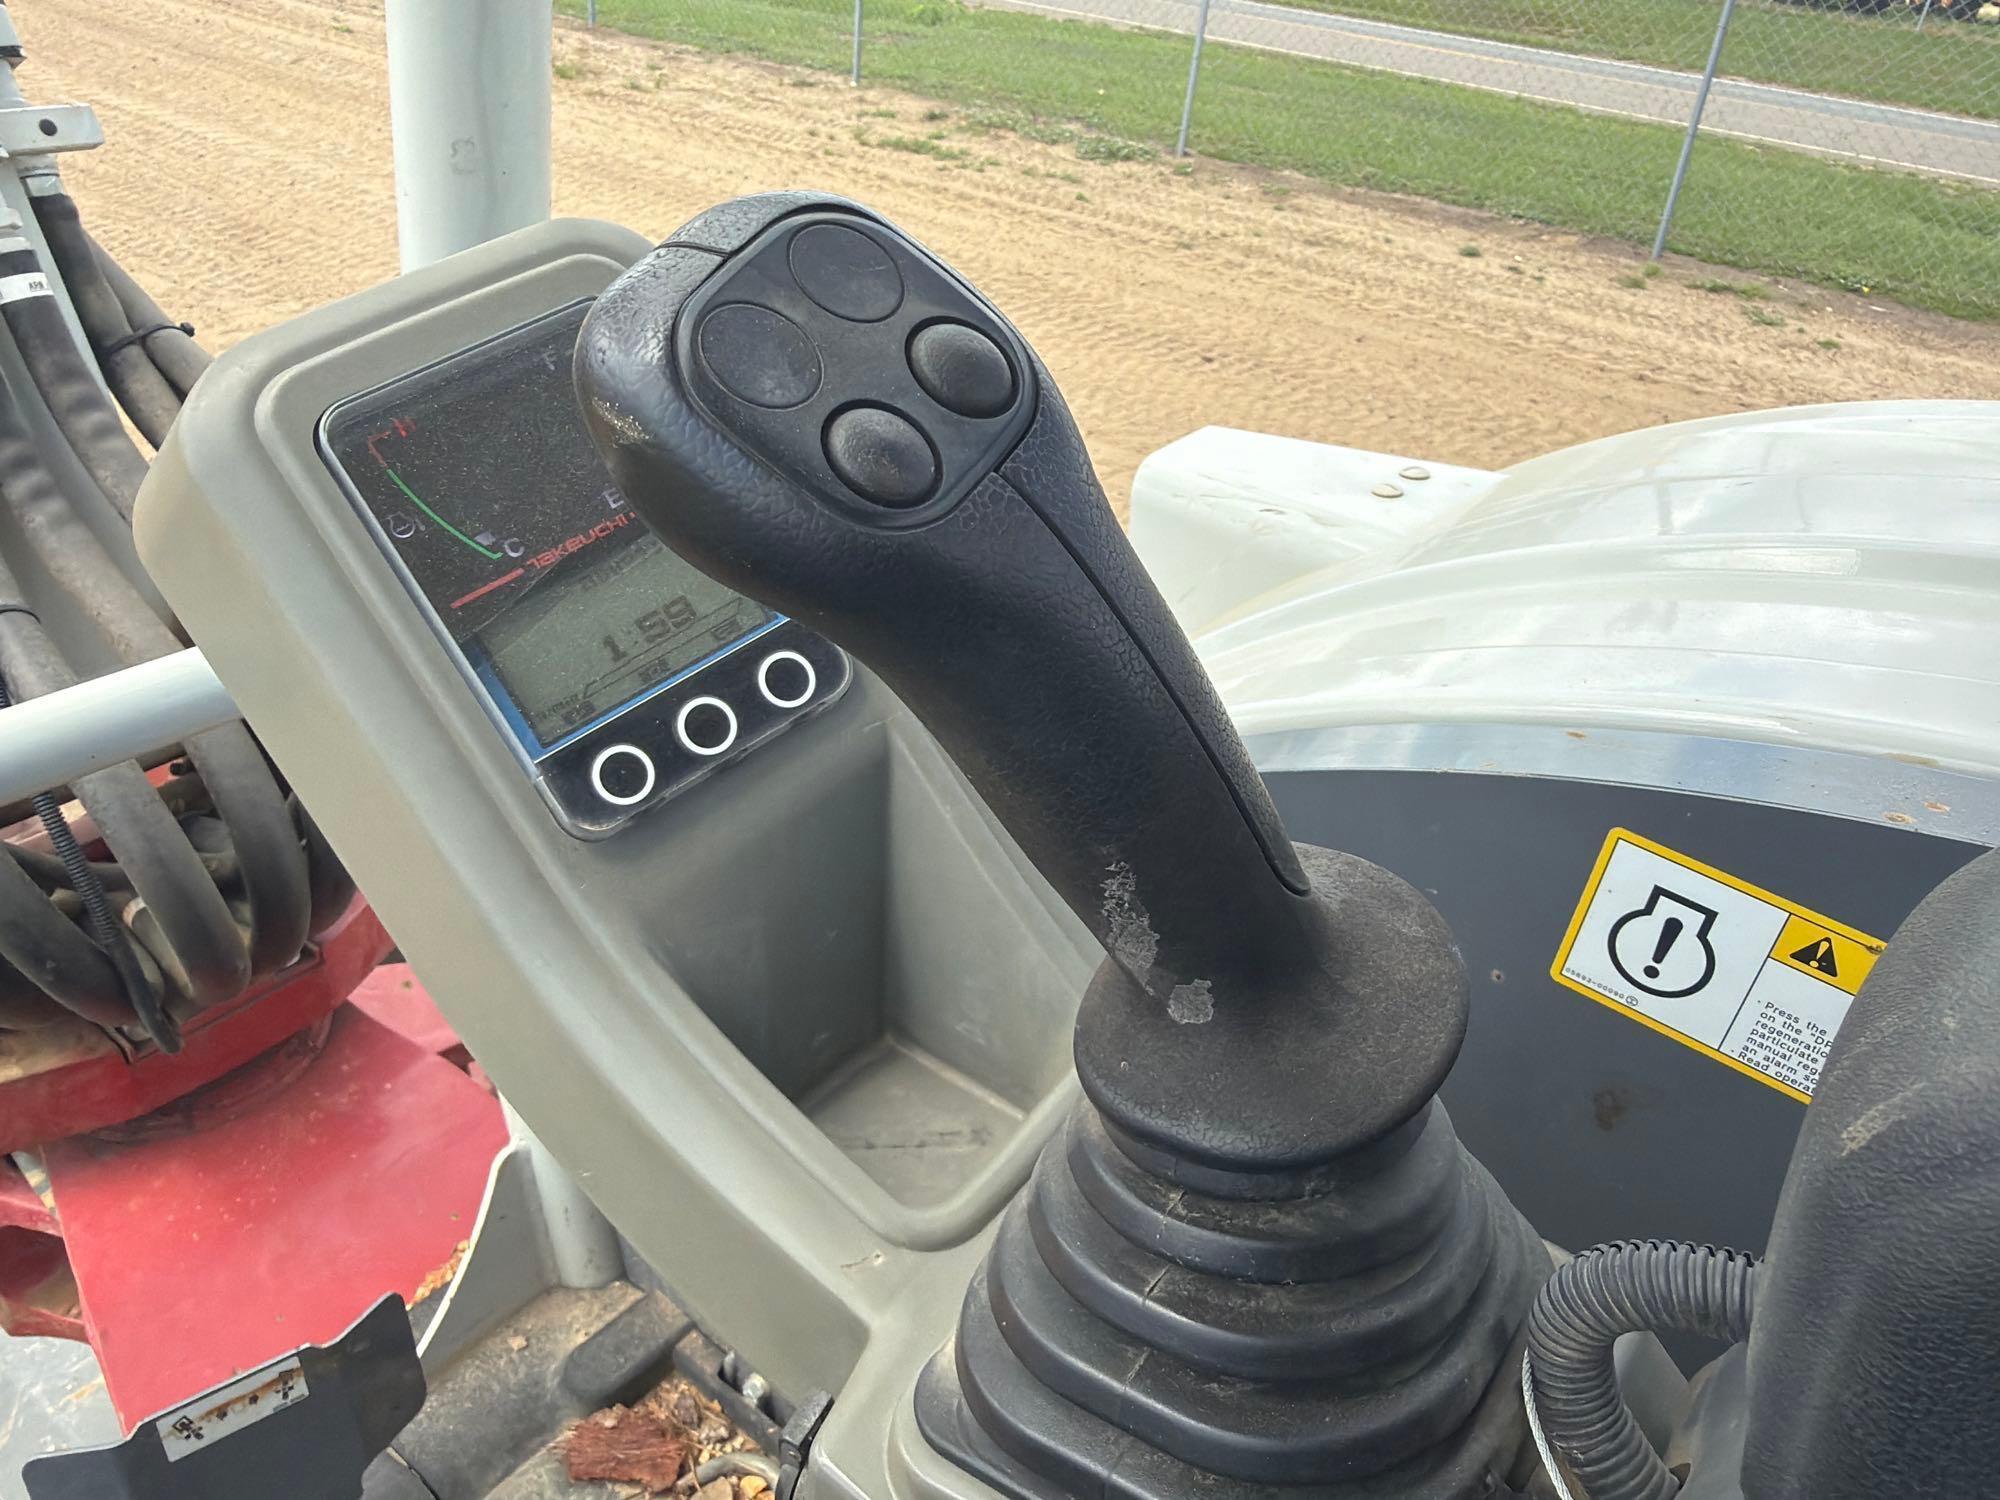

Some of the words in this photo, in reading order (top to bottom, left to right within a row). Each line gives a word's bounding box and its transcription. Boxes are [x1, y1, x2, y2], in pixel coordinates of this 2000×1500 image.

[601, 487, 625, 509] E
[503, 537, 525, 558] C
[1760, 1011, 1776, 1023] on
[1782, 1020, 1803, 1036] the
[1764, 1001, 1800, 1024] Press
[1806, 1021, 1827, 1037] the
[1746, 1036, 1792, 1061] manual
[1750, 1028, 1819, 1065] particulate
[1738, 1051, 1770, 1072] Read
[1742, 1044, 1758, 1056] an
[1762, 1054, 1798, 1075] alarm
